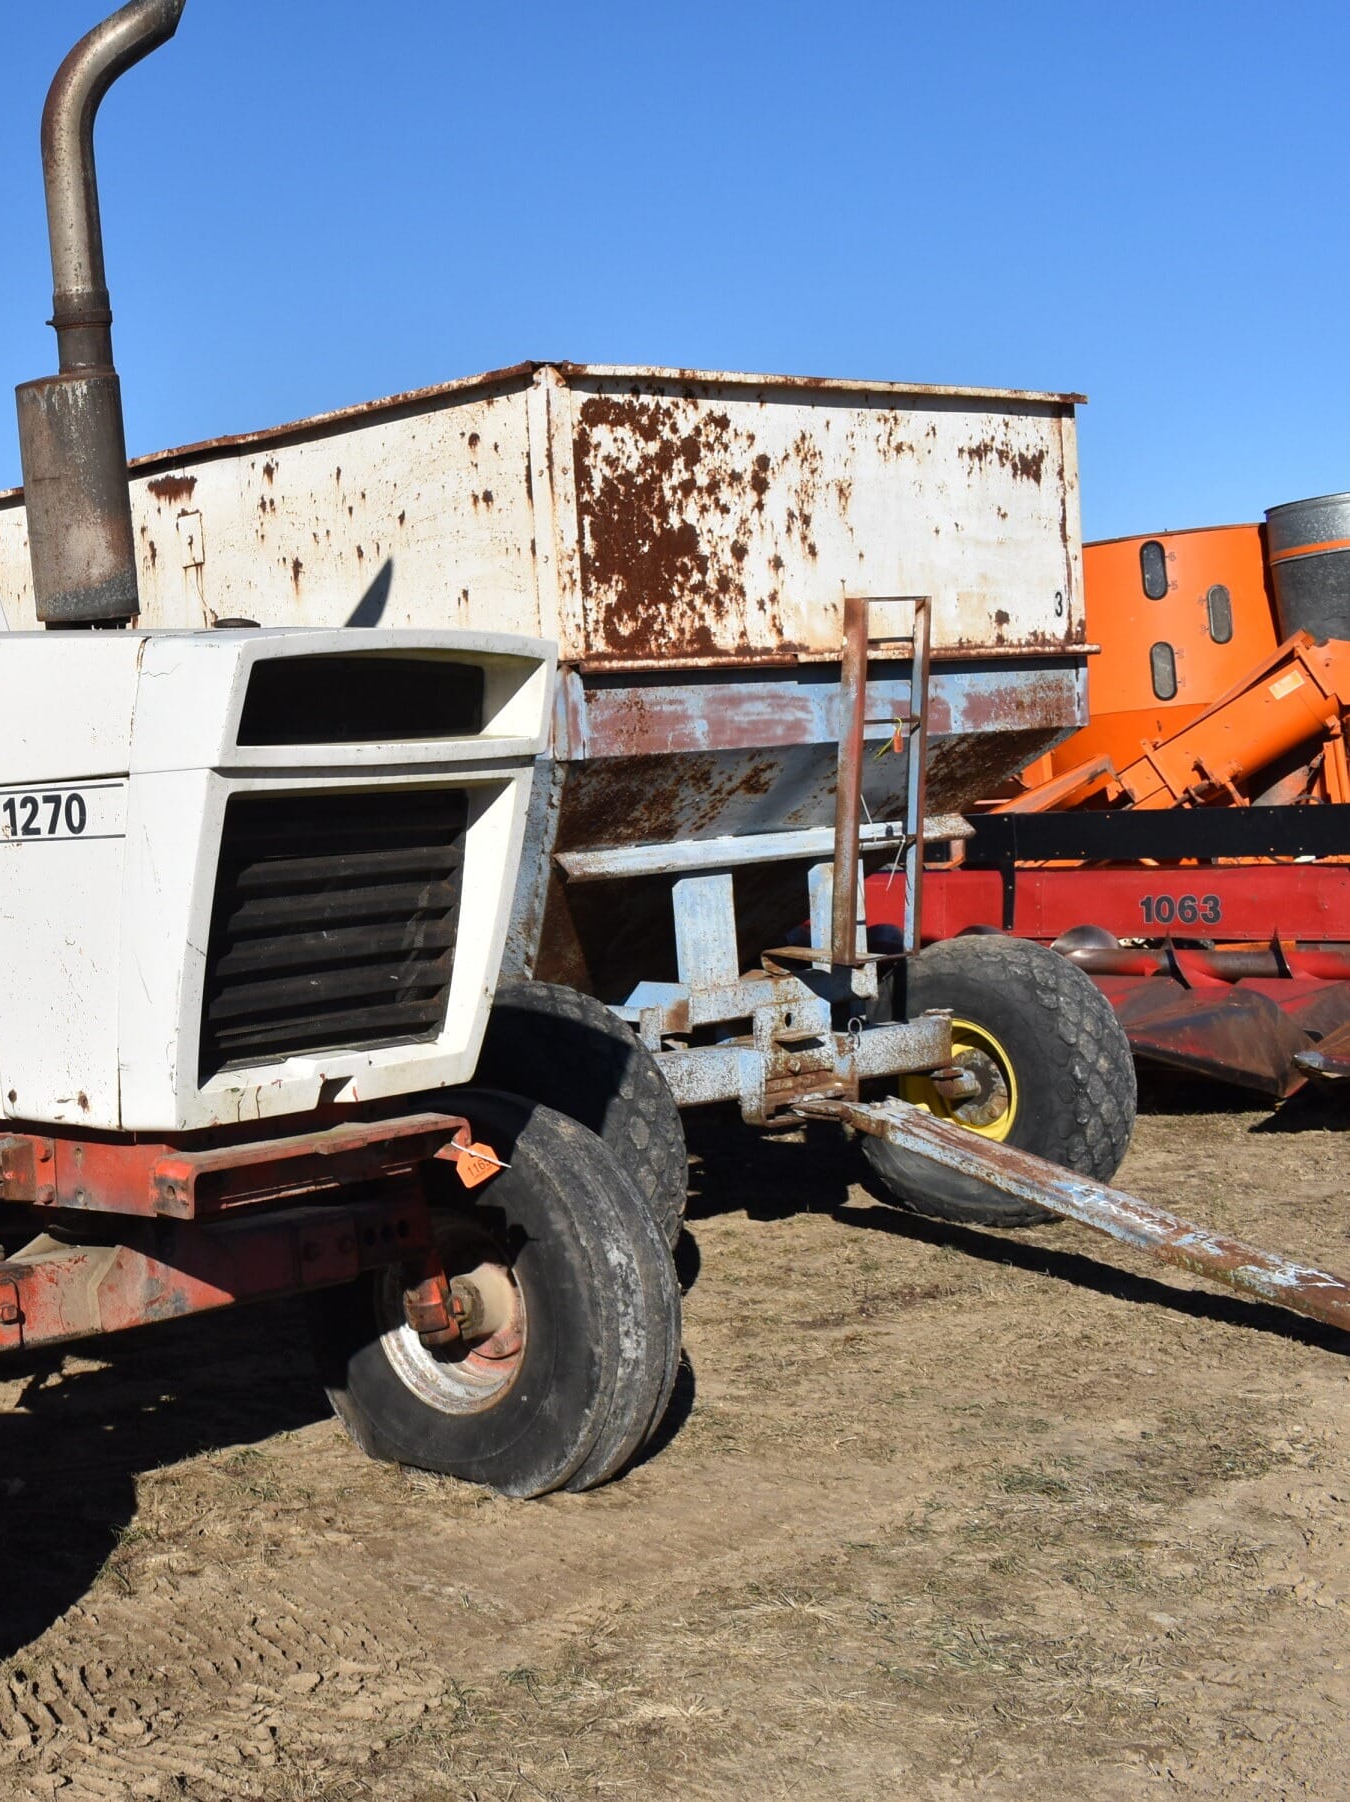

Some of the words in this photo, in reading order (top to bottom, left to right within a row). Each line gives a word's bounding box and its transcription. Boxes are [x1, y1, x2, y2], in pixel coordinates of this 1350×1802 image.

[1055, 591, 1063, 617] 3
[3, 793, 86, 836] 1270
[1139, 894, 1222, 925] 1063
